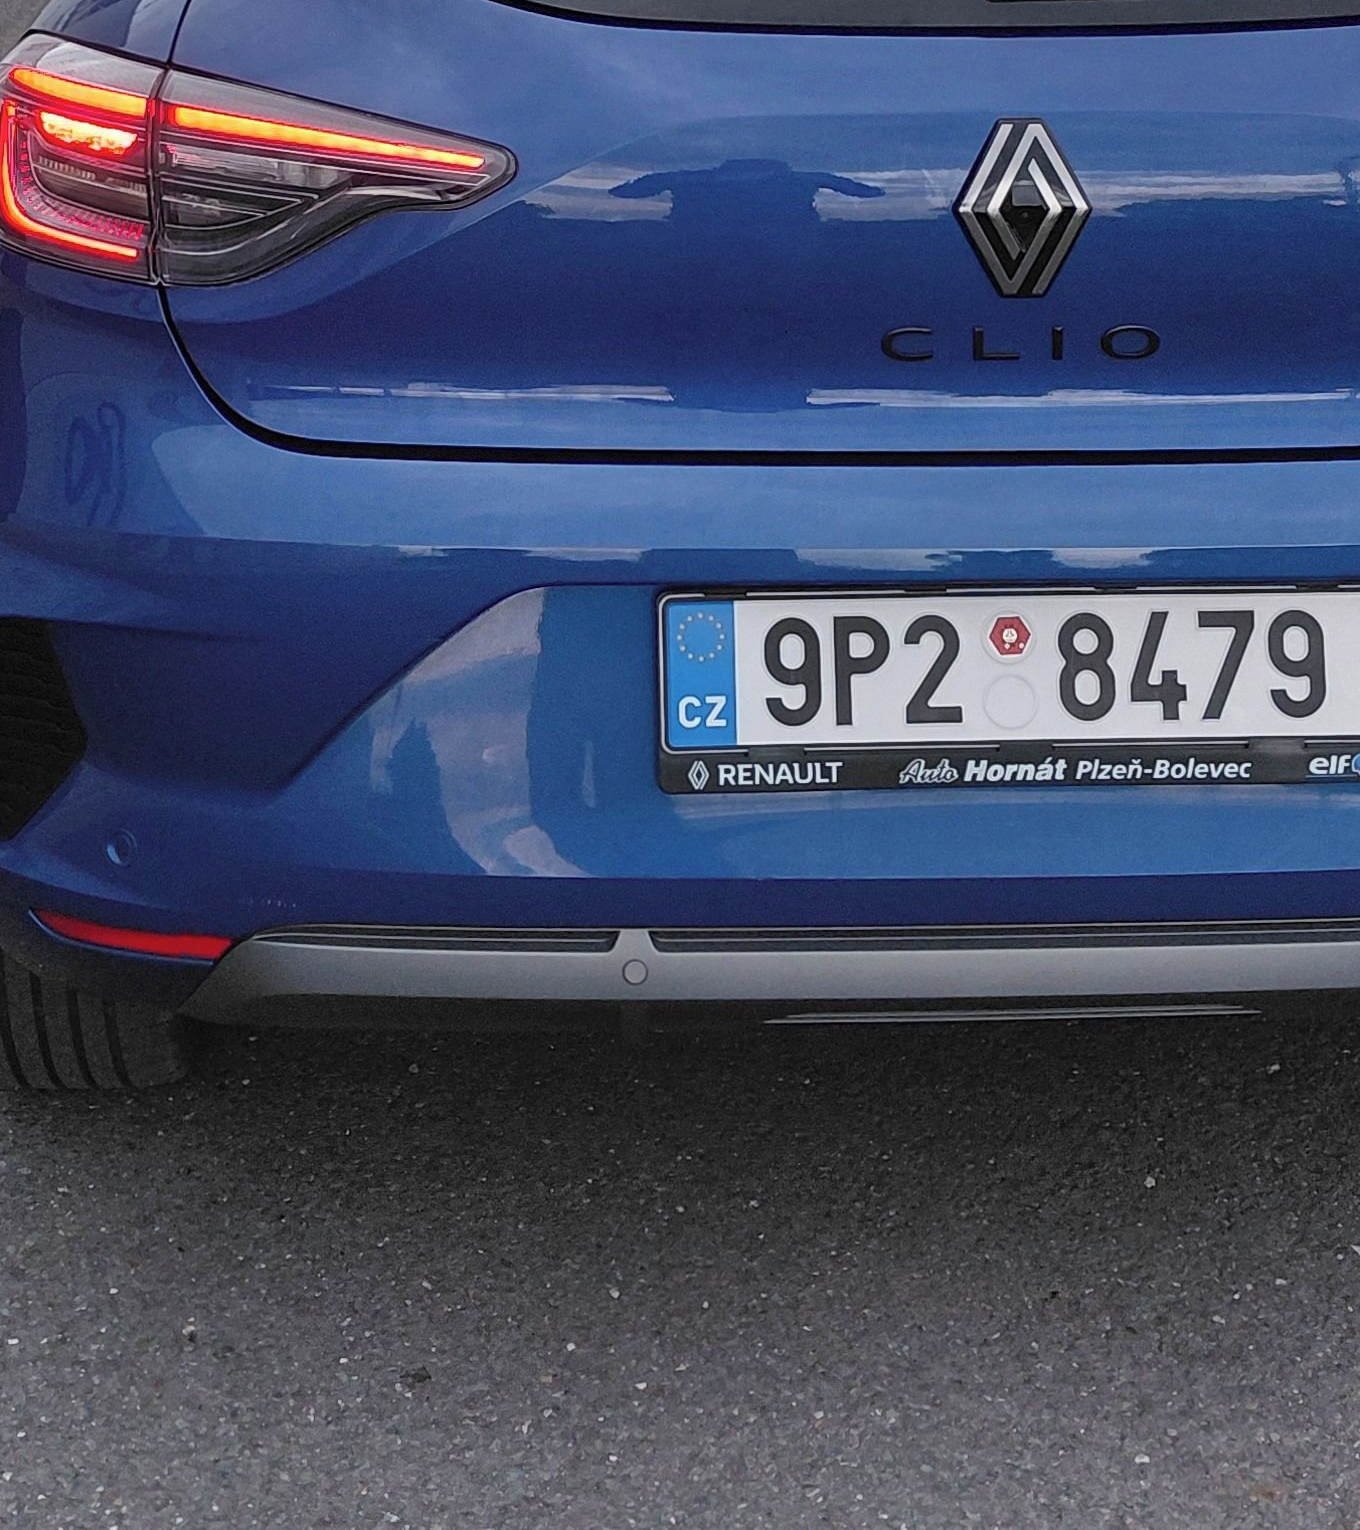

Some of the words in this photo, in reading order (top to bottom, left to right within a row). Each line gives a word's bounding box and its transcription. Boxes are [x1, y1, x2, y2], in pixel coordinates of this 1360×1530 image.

[880, 324, 1161, 362] CLIO
[763, 615, 964, 727] 9P2
[1056, 609, 1328, 722] 8479
[677, 696, 728, 728] CZ
[718, 762, 843, 786] RENAULT
[898, 758, 959, 785] Auto
[963, 757, 1066, 783] Hornát
[1074, 758, 1252, 781] Plzeň-Bolevec
[1307, 754, 1353, 775] elf
